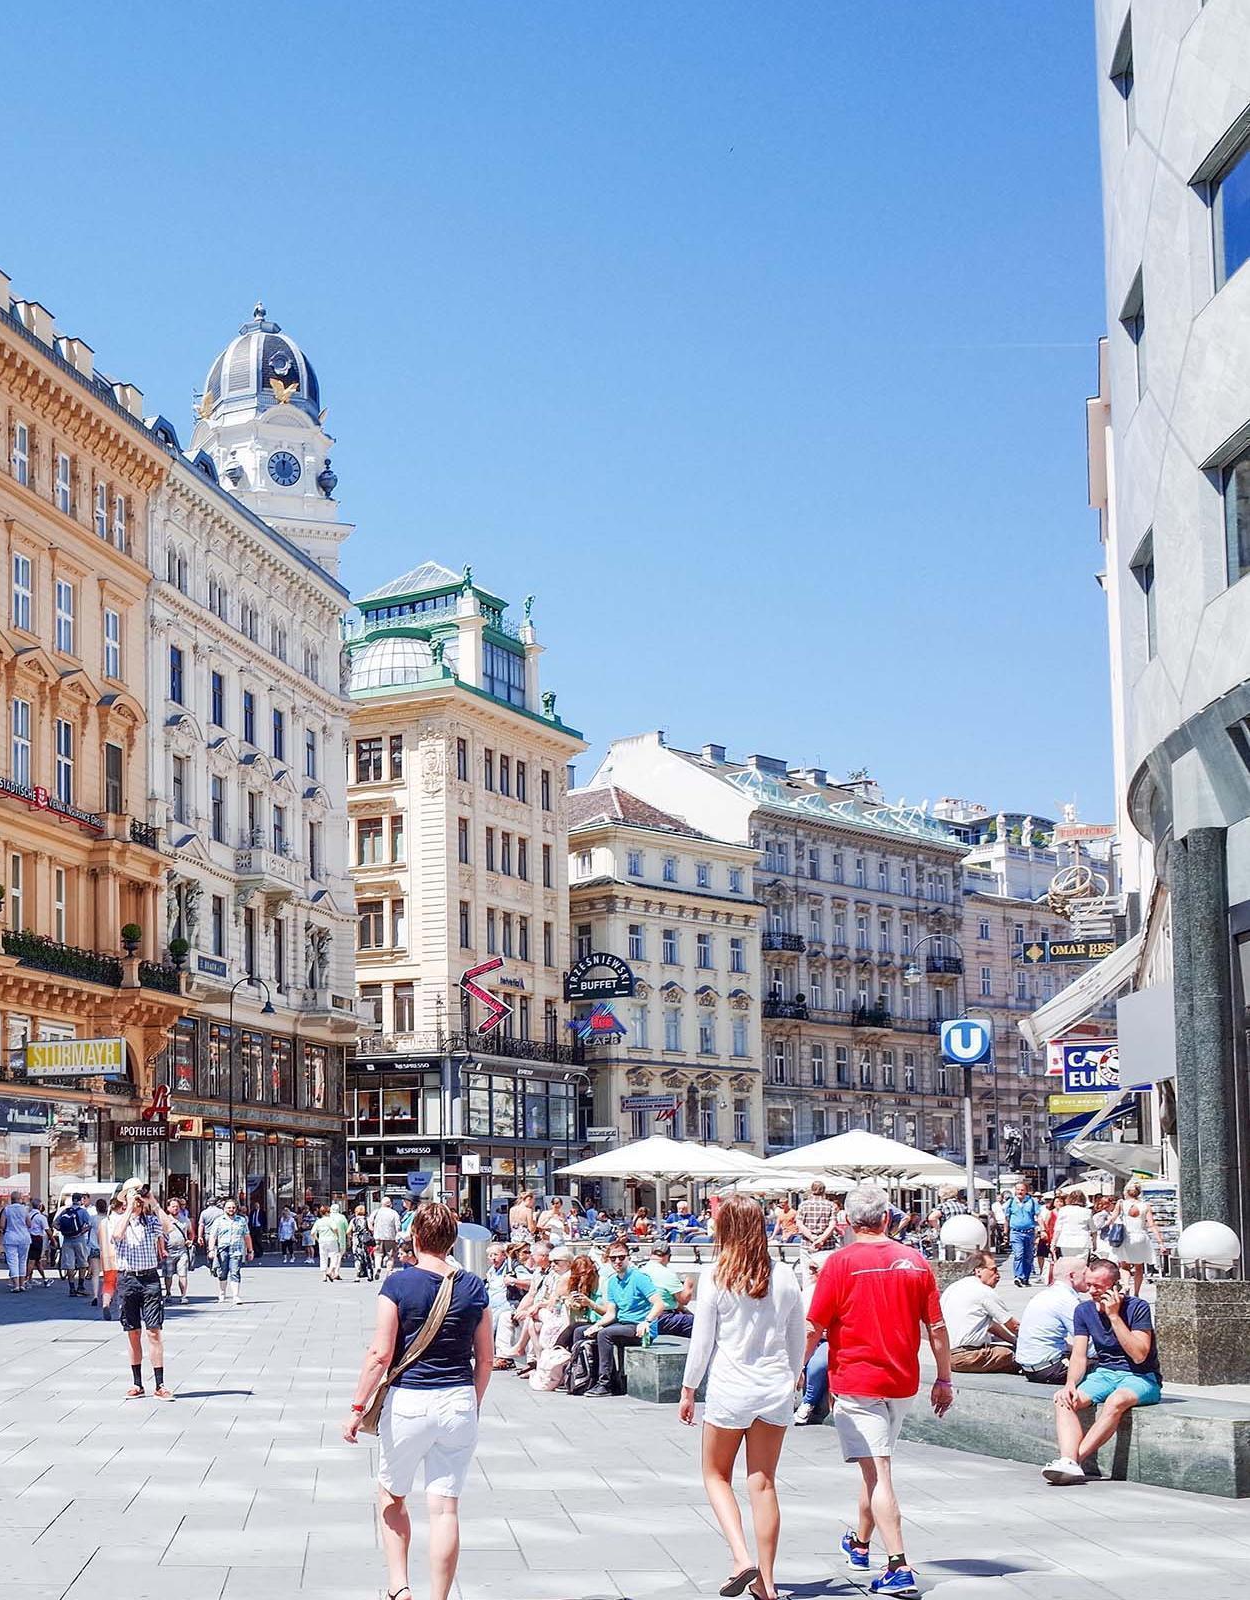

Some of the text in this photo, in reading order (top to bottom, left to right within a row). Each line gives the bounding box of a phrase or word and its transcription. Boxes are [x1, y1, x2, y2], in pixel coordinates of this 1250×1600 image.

[1050, 944, 1086, 956] OMAR
[580, 979, 618, 990] BUFFET
[950, 1028, 982, 1058] U
[33, 1042, 115, 1069] STURMAYR
[119, 1126, 166, 1137] APOTHEKE
